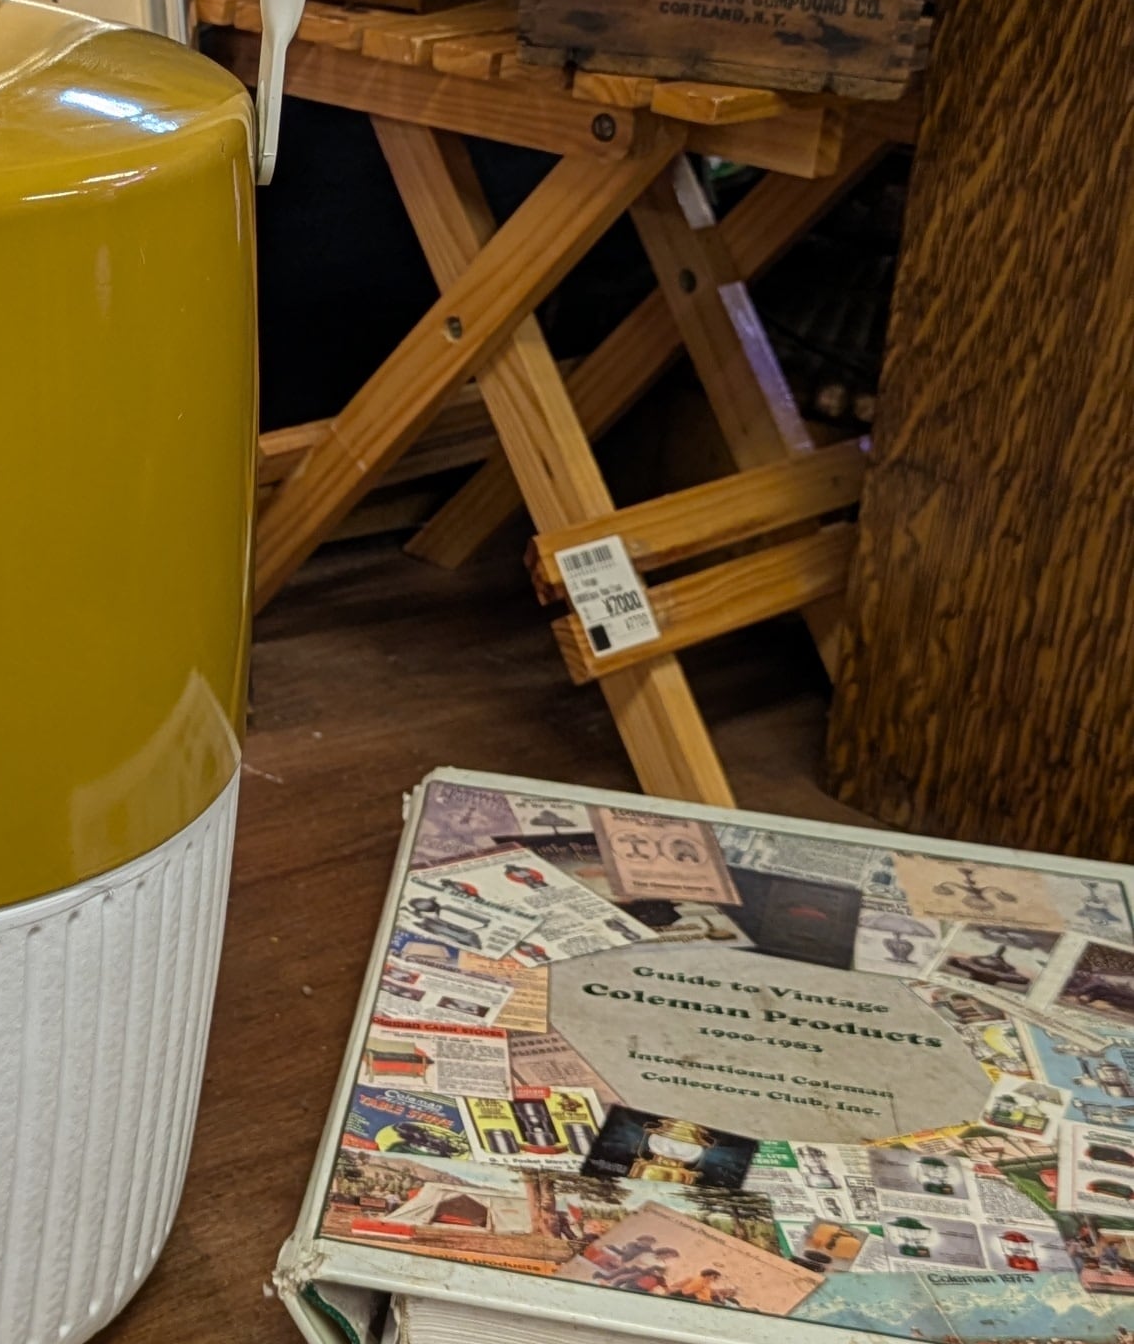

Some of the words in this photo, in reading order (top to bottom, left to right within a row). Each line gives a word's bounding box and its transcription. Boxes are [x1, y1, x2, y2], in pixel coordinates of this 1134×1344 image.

[632, 965, 722, 988] Guide
[730, 981, 761, 994] to
[768, 985, 890, 1014] Vintage
[581, 982, 751, 1020] Coleman
[763, 1008, 943, 1049] Products
[698, 1026, 825, 1054] 1900-1983
[627, 1049, 785, 1083] International
[791, 1074, 895, 1099] Coleman
[640, 1071, 761, 1098] Collectors
[767, 1089, 832, 1108] Club,
[836, 1101, 881, 1116] Inc.
[927, 1272, 996, 1285] Coleman
[998, 1273, 1034, 1284] 1975
